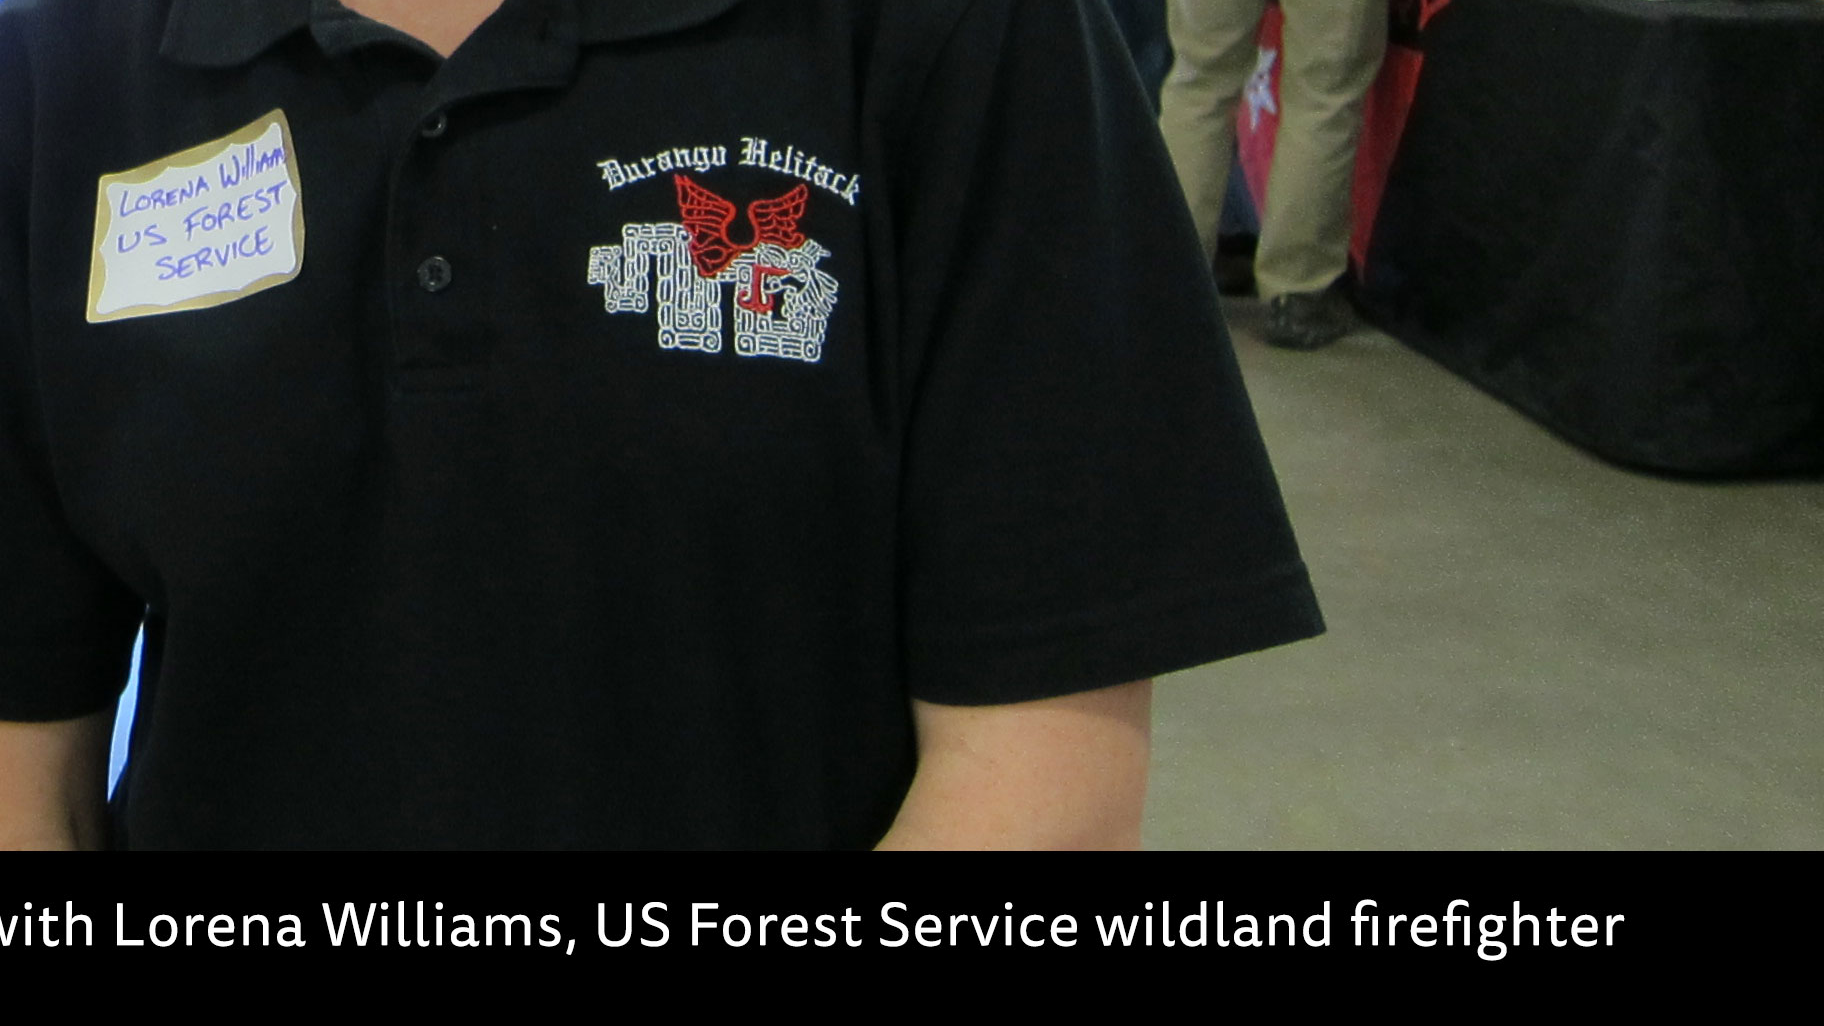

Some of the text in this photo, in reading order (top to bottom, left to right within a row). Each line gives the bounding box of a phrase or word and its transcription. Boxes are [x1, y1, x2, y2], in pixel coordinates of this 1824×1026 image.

[119, 177, 209, 218] LORENA
[596, 136, 861, 206] Durango Helitack
[117, 180, 288, 254] US FOREST
[155, 226, 275, 281] SERVICE
